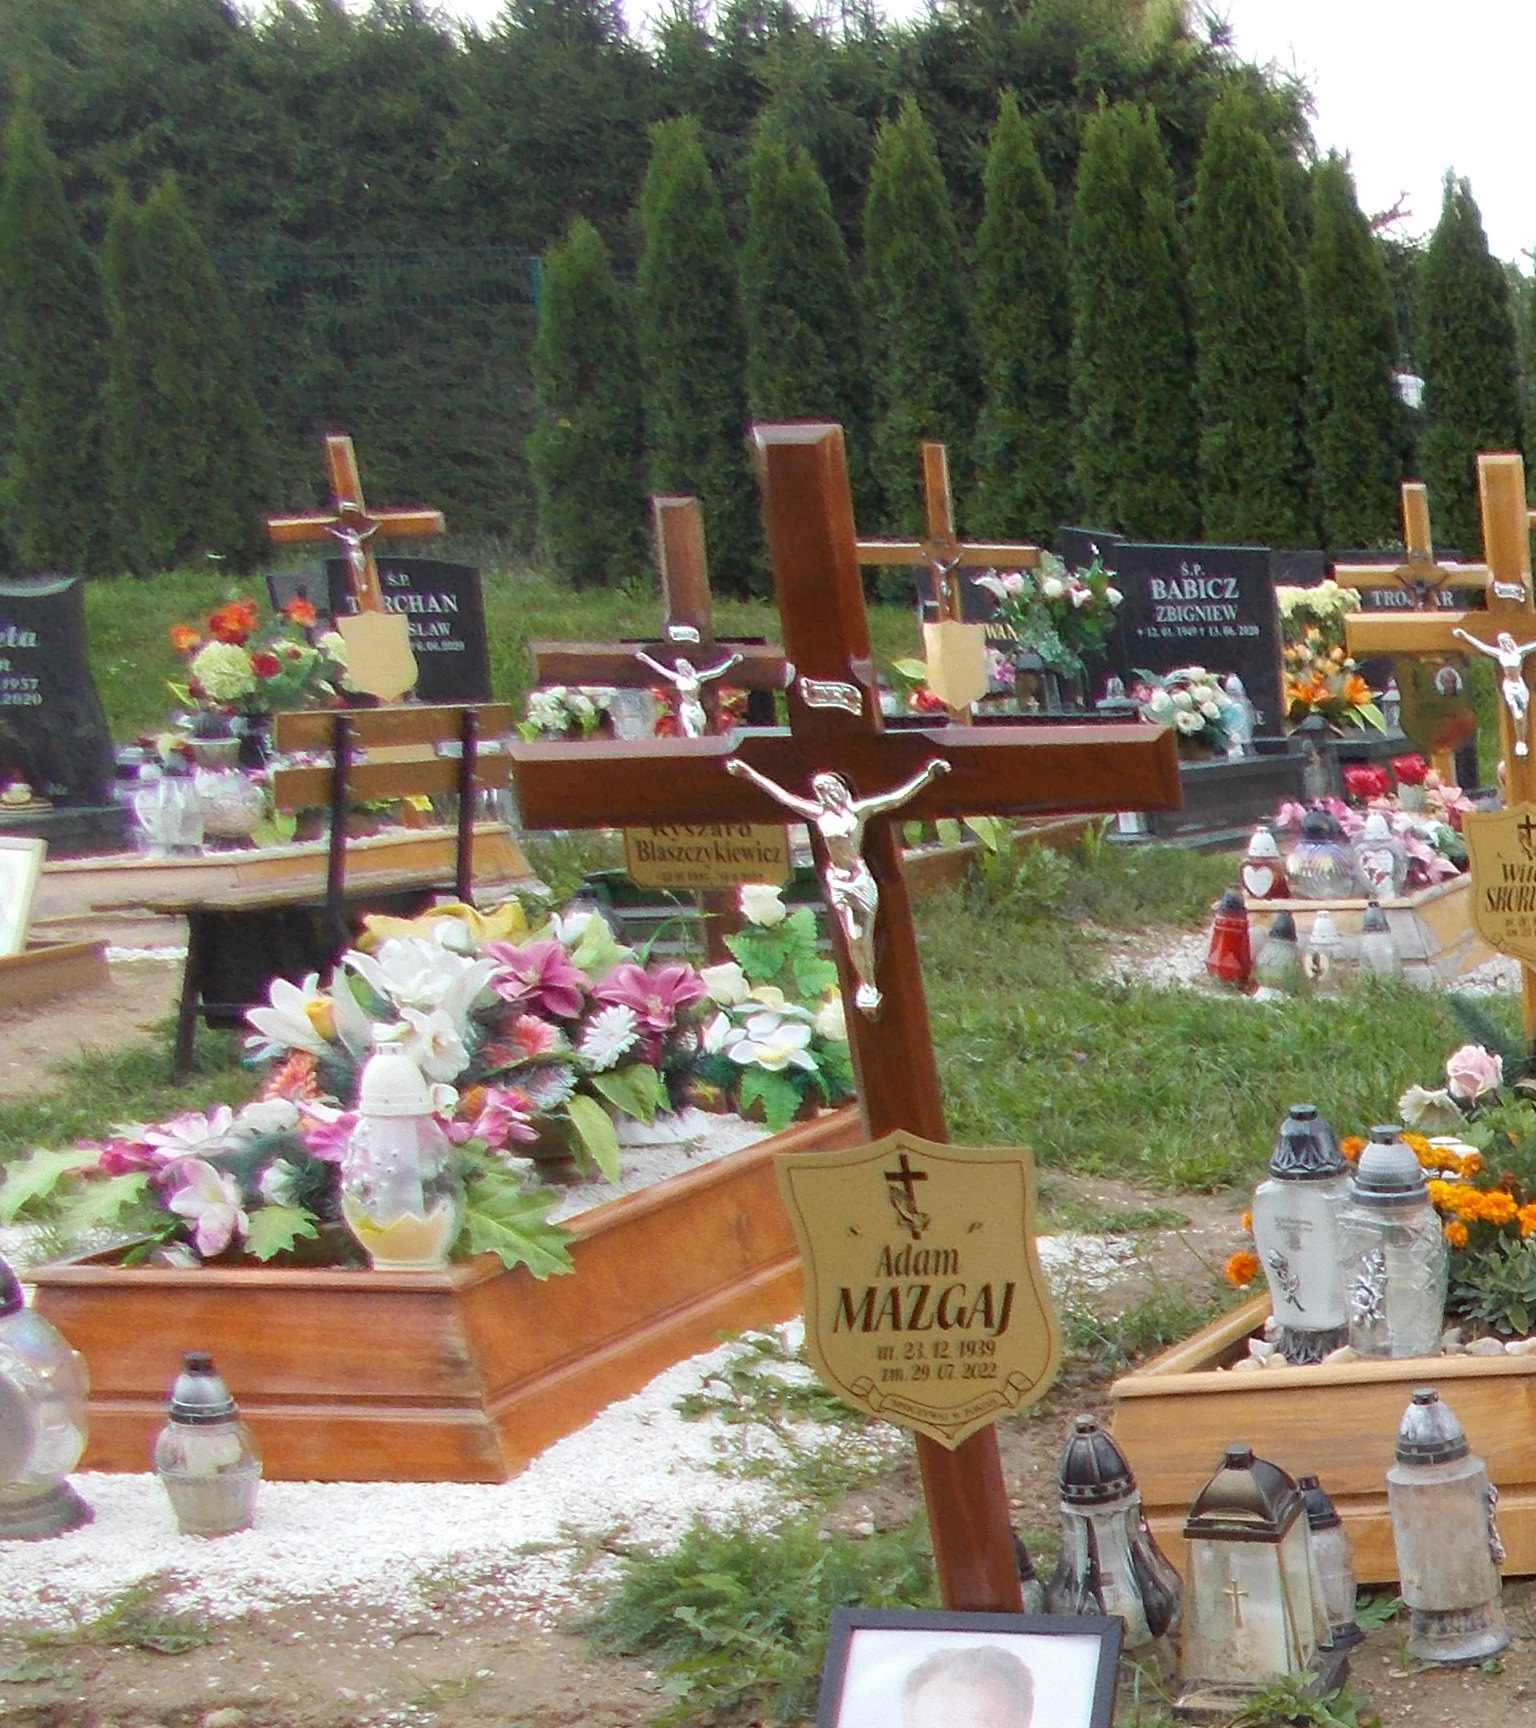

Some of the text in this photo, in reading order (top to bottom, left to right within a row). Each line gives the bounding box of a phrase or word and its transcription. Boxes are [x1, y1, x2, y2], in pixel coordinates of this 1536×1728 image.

[1150, 577, 1241, 601] BABICZ
[346, 593, 459, 614] TRCHAN
[1155, 603, 1241, 623] ZBIGNIEW
[875, 1242, 960, 1278] Adam
[832, 1281, 1017, 1338] MAZGAJ
[959, 1339, 997, 1358] 1939
[961, 1362, 999, 1380] 2022
